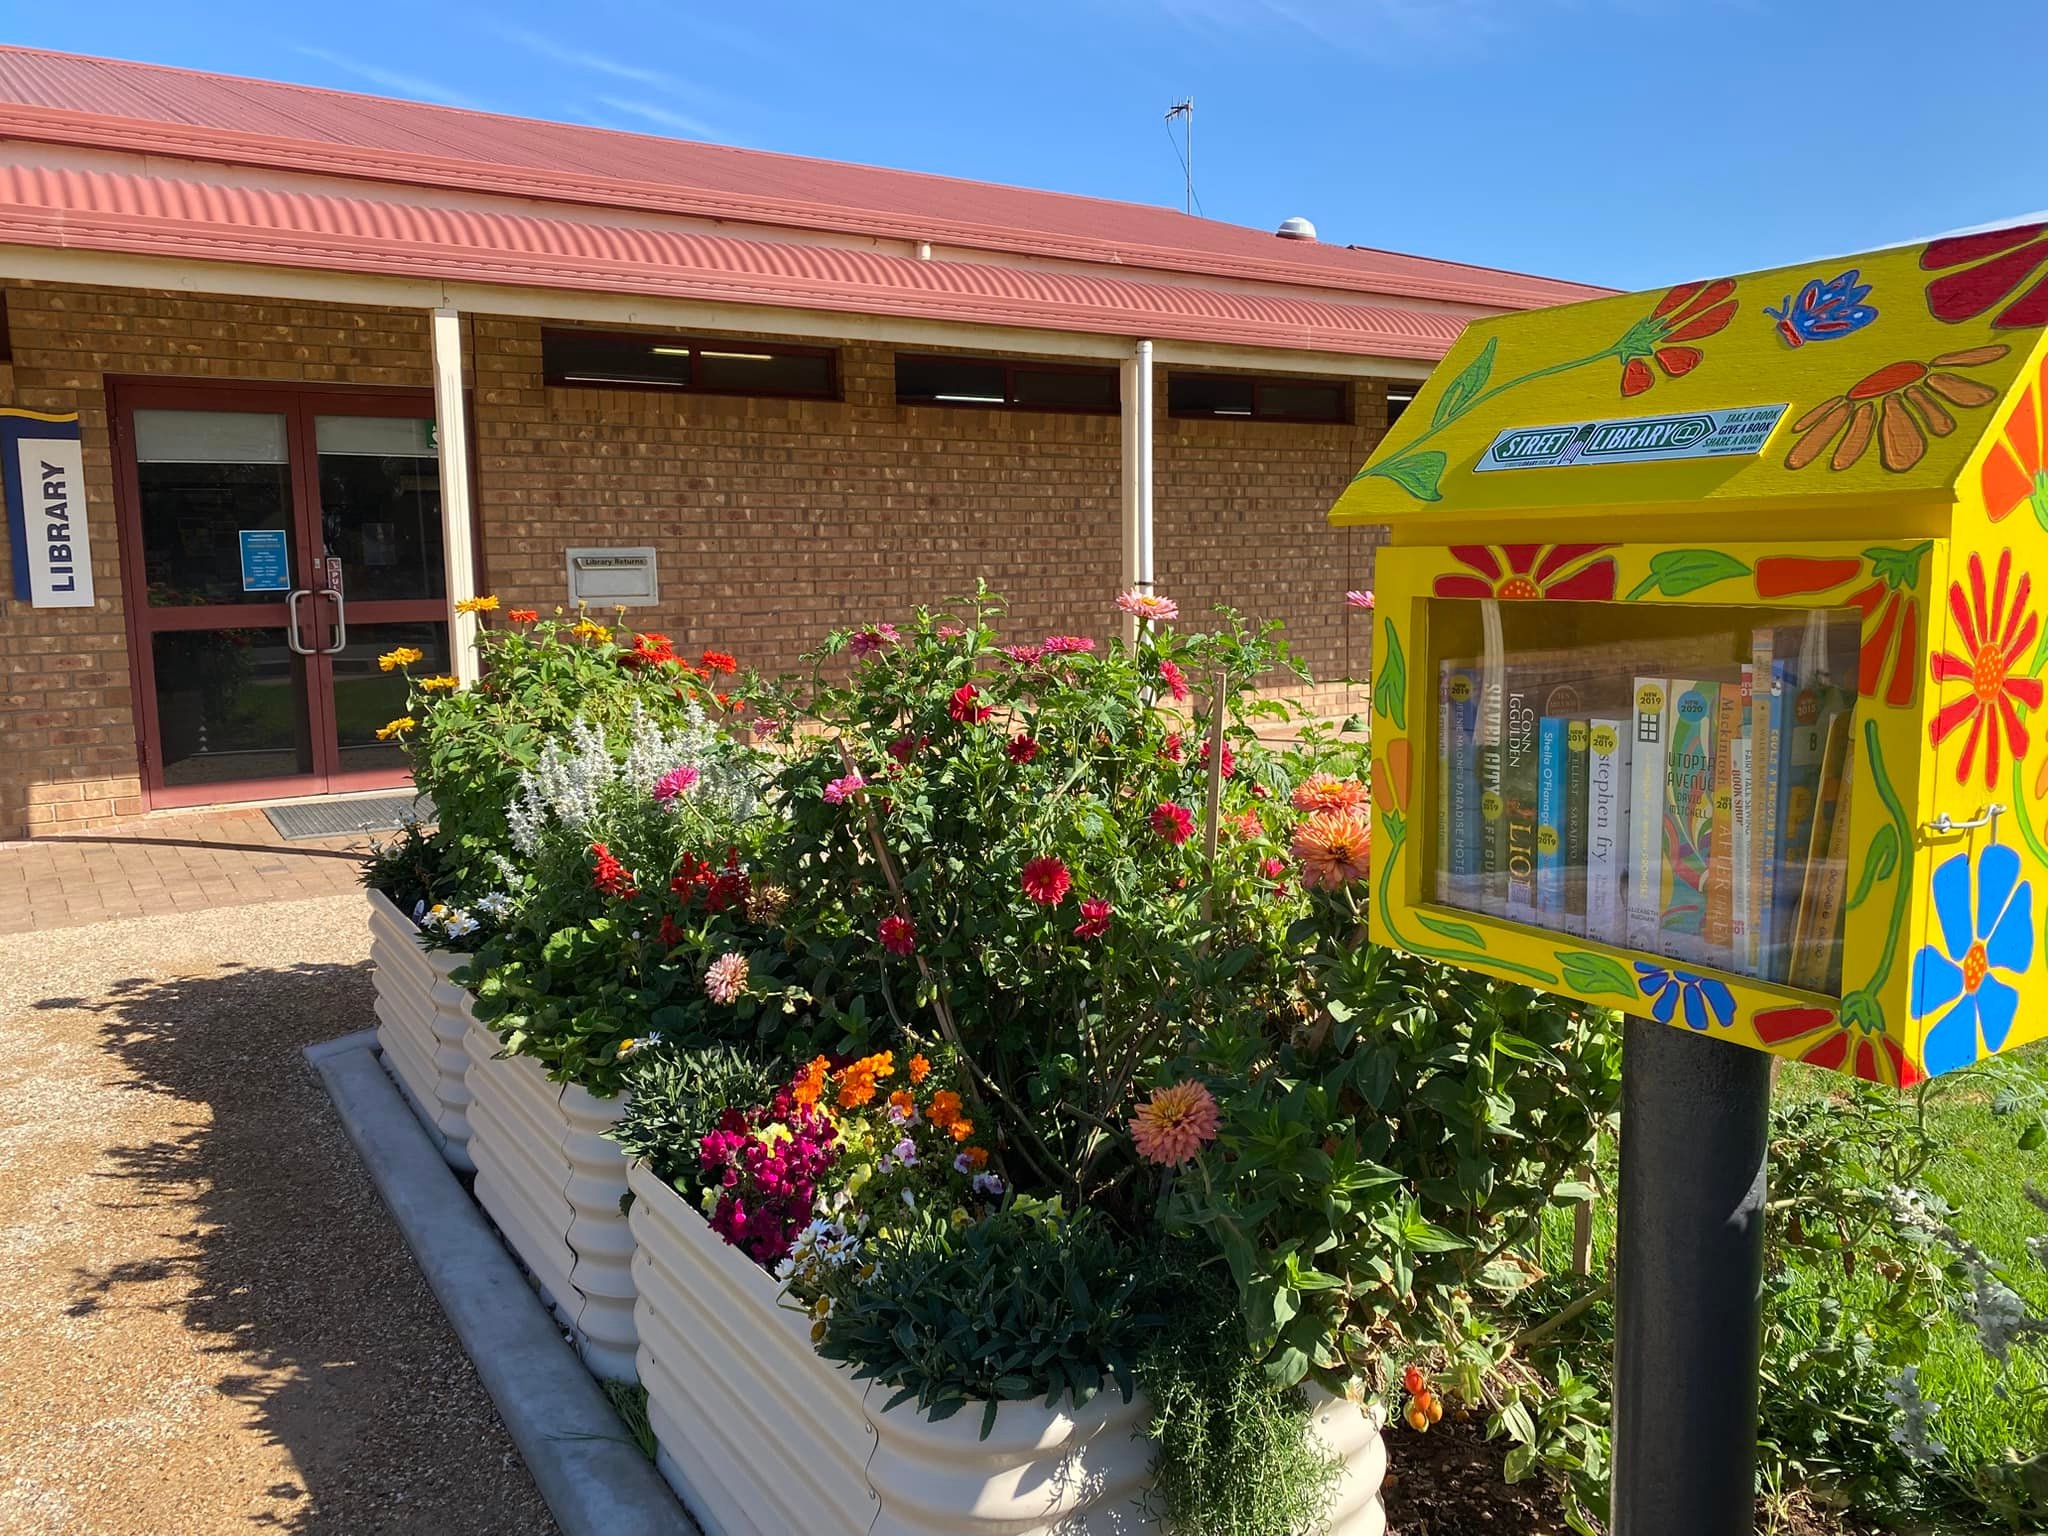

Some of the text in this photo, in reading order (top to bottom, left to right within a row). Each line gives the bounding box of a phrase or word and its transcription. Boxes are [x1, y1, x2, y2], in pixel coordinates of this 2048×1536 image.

[1718, 420, 1774, 435] GIVE A BOOK
[1726, 409, 1781, 423] TAKE A BOOK
[1502, 423, 1677, 457] STREET LIBRARY
[1702, 432, 1766, 448] SHARE A BOOK
[40, 459, 75, 592] LIBRARY
[585, 558, 644, 567] Library Returns
[1452, 687, 1470, 695] 2019
[1640, 697, 1662, 705] 2019
[1681, 705, 1703, 713] 2020
[1484, 683, 1501, 796] SILVER CITY
[1509, 692, 1525, 768] IGGULDEN
[1521, 707, 1534, 753] CONN
[1568, 734, 1587, 742] 2019
[1717, 697, 1734, 785] Mackintosh
[1593, 739, 1614, 748] 2019
[1668, 752, 1716, 771] UTOPIA
[1541, 732, 1553, 827] Sheila O'Flanaga
[1667, 772, 1715, 792] AVENUE
[1732, 769, 1743, 797] BOOK
[1593, 755, 1614, 828] stephen
[1677, 792, 1702, 805] DAVID
[1455, 782, 1464, 835] PARADISE
[1669, 804, 1708, 819] MITCHELL
[1717, 801, 1732, 810] 201
[1484, 817, 1495, 843] EFF
[1455, 838, 1464, 880] HOTEL
[1592, 835, 1613, 864] fry
[1714, 824, 1733, 891] AFTER
